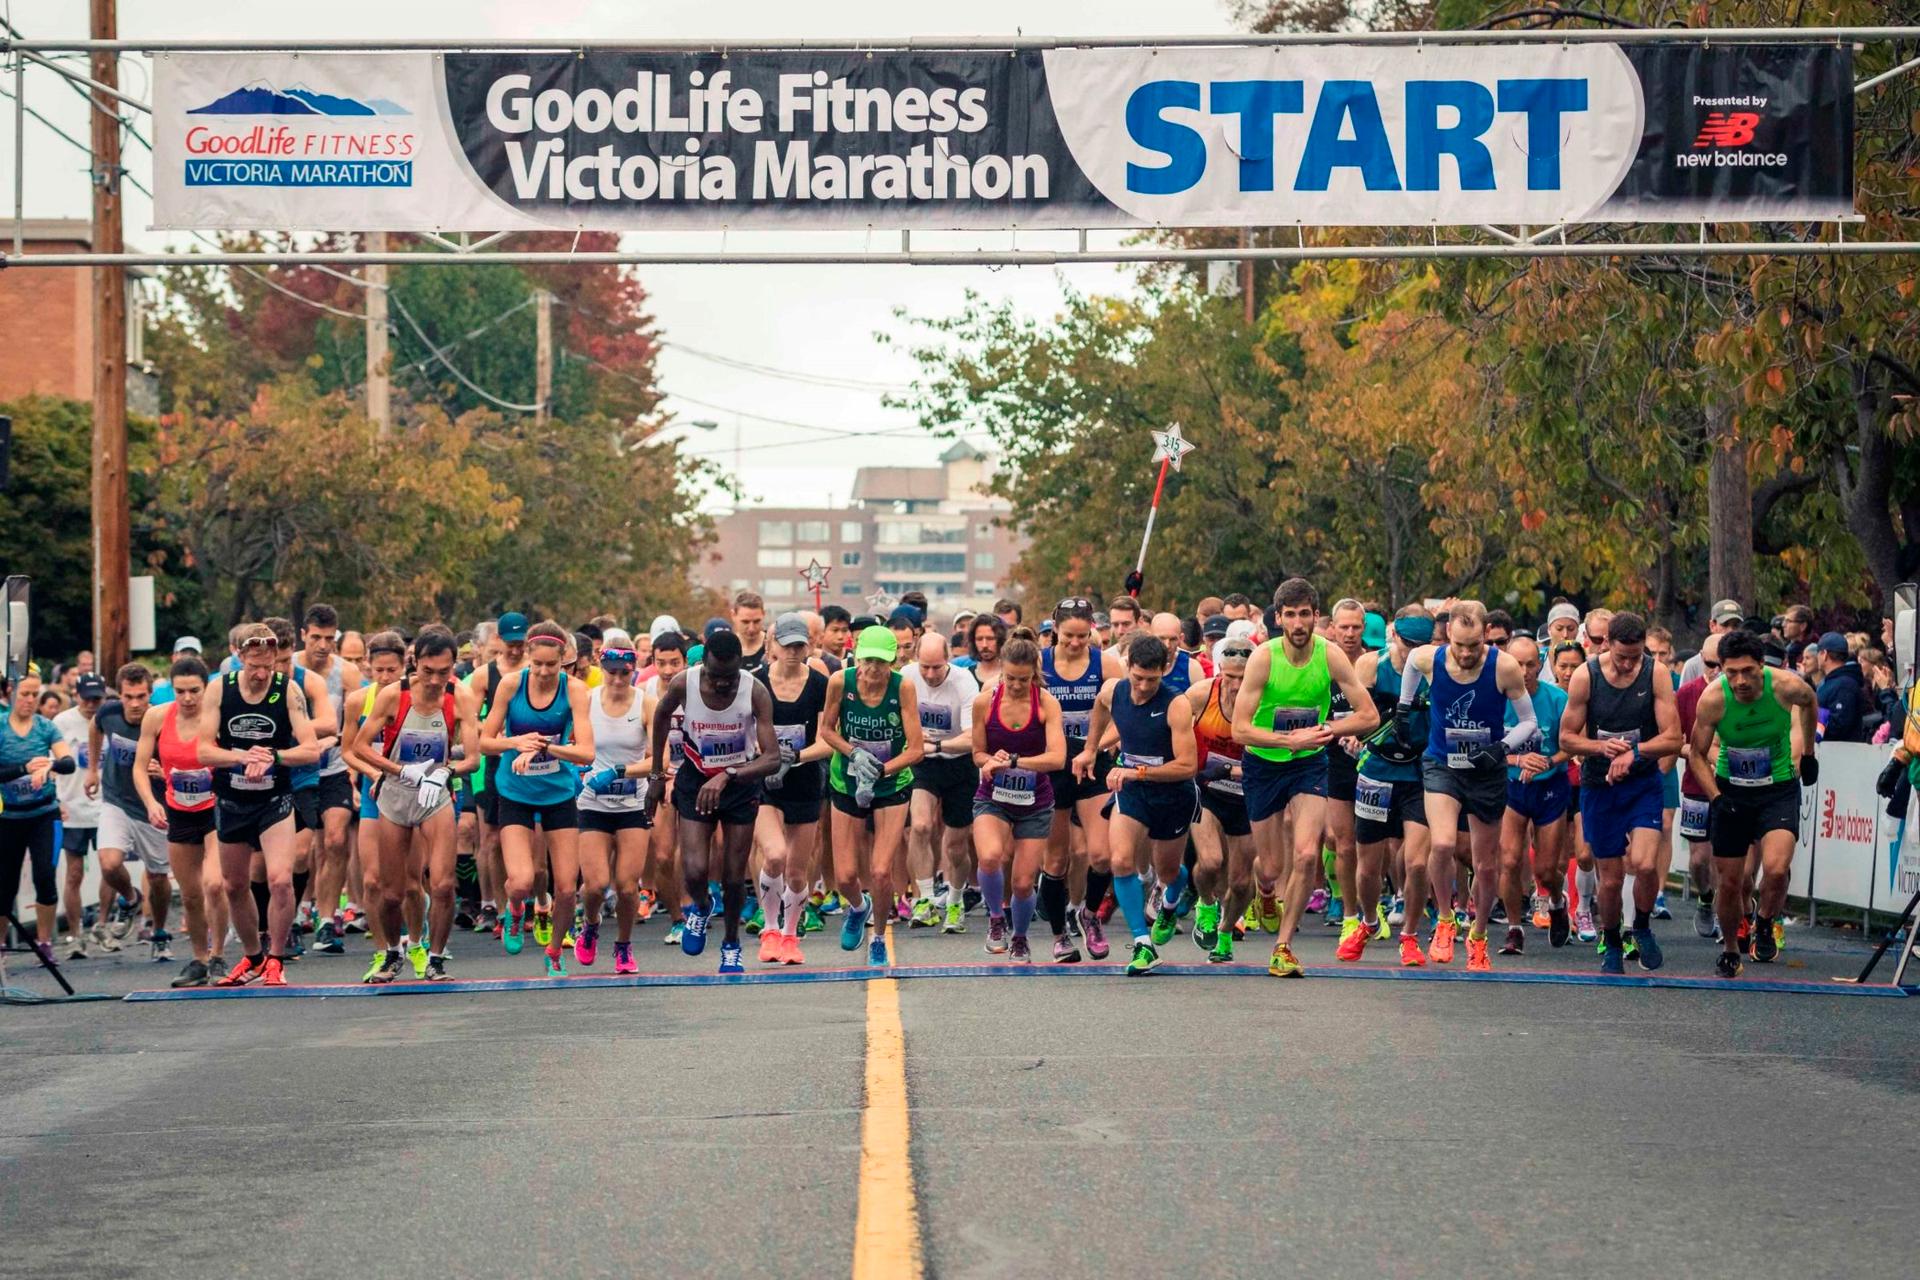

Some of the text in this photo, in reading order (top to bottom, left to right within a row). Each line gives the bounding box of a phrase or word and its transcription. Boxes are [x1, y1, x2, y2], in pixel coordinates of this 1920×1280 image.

[485, 70, 988, 134] GoodLife Fitness
[1693, 96, 1767, 108] Presented by
[185, 126, 413, 156] GoodLife FITNESS
[1125, 78, 1588, 195] START
[1677, 150, 1788, 167] new balance
[189, 163, 410, 184] VICTORIA MARATHON
[503, 137, 1049, 200] Victoria Marathon
[846, 711, 886, 727] Guelph
[413, 743, 431, 757] 42
[714, 743, 734, 756] M1
[1741, 760, 1756, 774] 41
[1360, 791, 1380, 806] M8
